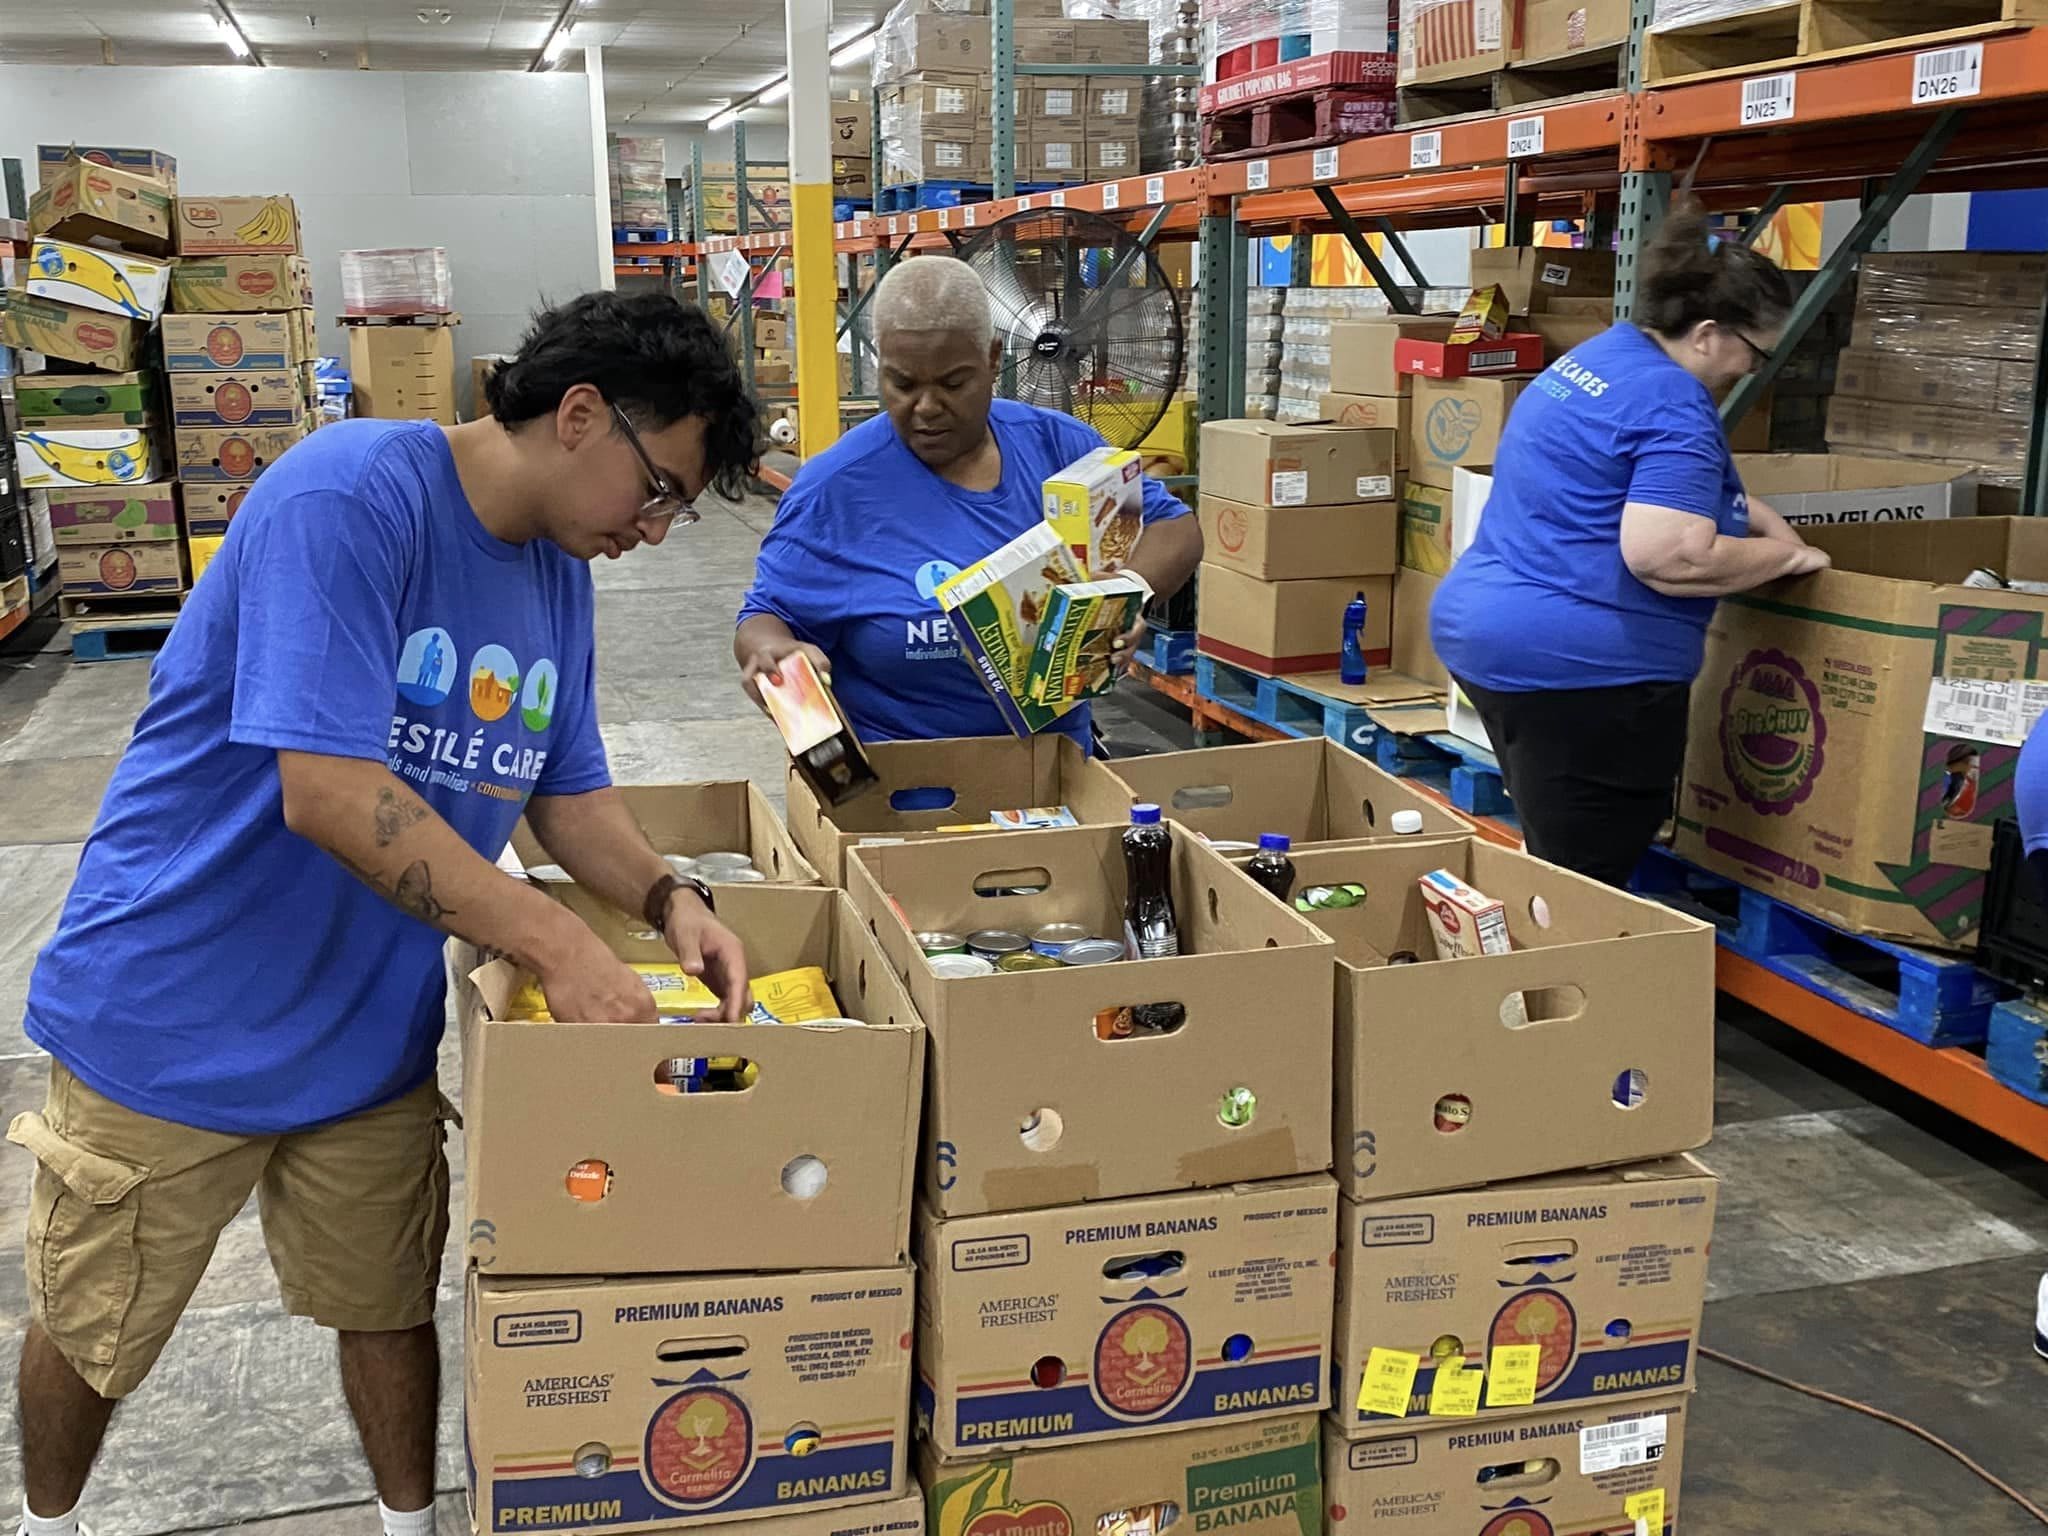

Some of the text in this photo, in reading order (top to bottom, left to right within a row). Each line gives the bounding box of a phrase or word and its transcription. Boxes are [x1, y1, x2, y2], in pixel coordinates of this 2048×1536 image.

[1245, 75, 1276, 96] POPCORN
[1277, 71, 1292, 89] BAG
[1918, 76, 1958, 98] DN26
[1745, 102, 1777, 120] DN25
[1510, 139, 1532, 154] DN24
[1413, 152, 1431, 165] DN23
[189, 207, 216, 219] Dole
[1561, 362, 1609, 398] CARES
[1783, 505, 1925, 527] TERMELONS
[907, 618, 960, 645] NE
[905, 645, 958, 660] individuals
[977, 621, 1009, 667] VALLEY
[1045, 652, 1066, 700] NATURE
[1058, 603, 1089, 648] VALLEY
[977, 655, 1005, 693] 20 BARS
[388, 716, 485, 770] ESTLÉ
[492, 743, 547, 781] CARE
[403, 762, 430, 783] and
[1243, 1207, 1328, 1221] PRODUCT OF MEXICO
[1467, 1206, 1607, 1228] PREMIUM BANANAS
[1066, 1216, 1218, 1245] PREMIUM BANANAS
[1218, 1268, 1235, 1278] BEST
[1266, 1263, 1291, 1273] SUPPLY
[1384, 1273, 1459, 1289] AMERICAS'
[811, 1288, 903, 1303] PRODUCT OF MEXICO
[978, 1294, 1059, 1314] AMERICAS'
[1386, 1287, 1457, 1303] FRESHEST
[615, 1297, 784, 1323] PREMIUM BANANAS
[981, 1309, 1057, 1328] FRESHEST
[520, 1329, 553, 1338] POUNDS
[830, 1330, 840, 1339] DE
[523, 1374, 615, 1393] AMERICAS'
[1593, 1365, 1682, 1392] BANANAS
[526, 1389, 612, 1408] FRESHEST
[1115, 1383, 1174, 1401] Carmelita
[961, 1383, 1315, 1441] PREMIUM BANANAS
[1263, 1422, 1300, 1437] STORE AT
[1448, 1420, 1584, 1450] PREMIUM BANANAS
[671, 1469, 731, 1486] Carmelita
[499, 1469, 887, 1526] PREMIUM BANANAS
[1194, 1472, 1297, 1507] Premium
[1372, 1491, 1446, 1508] AMERICAS'
[1374, 1503, 1440, 1519] FRESHEST
[886, 1520, 919, 1533] MEXICO
